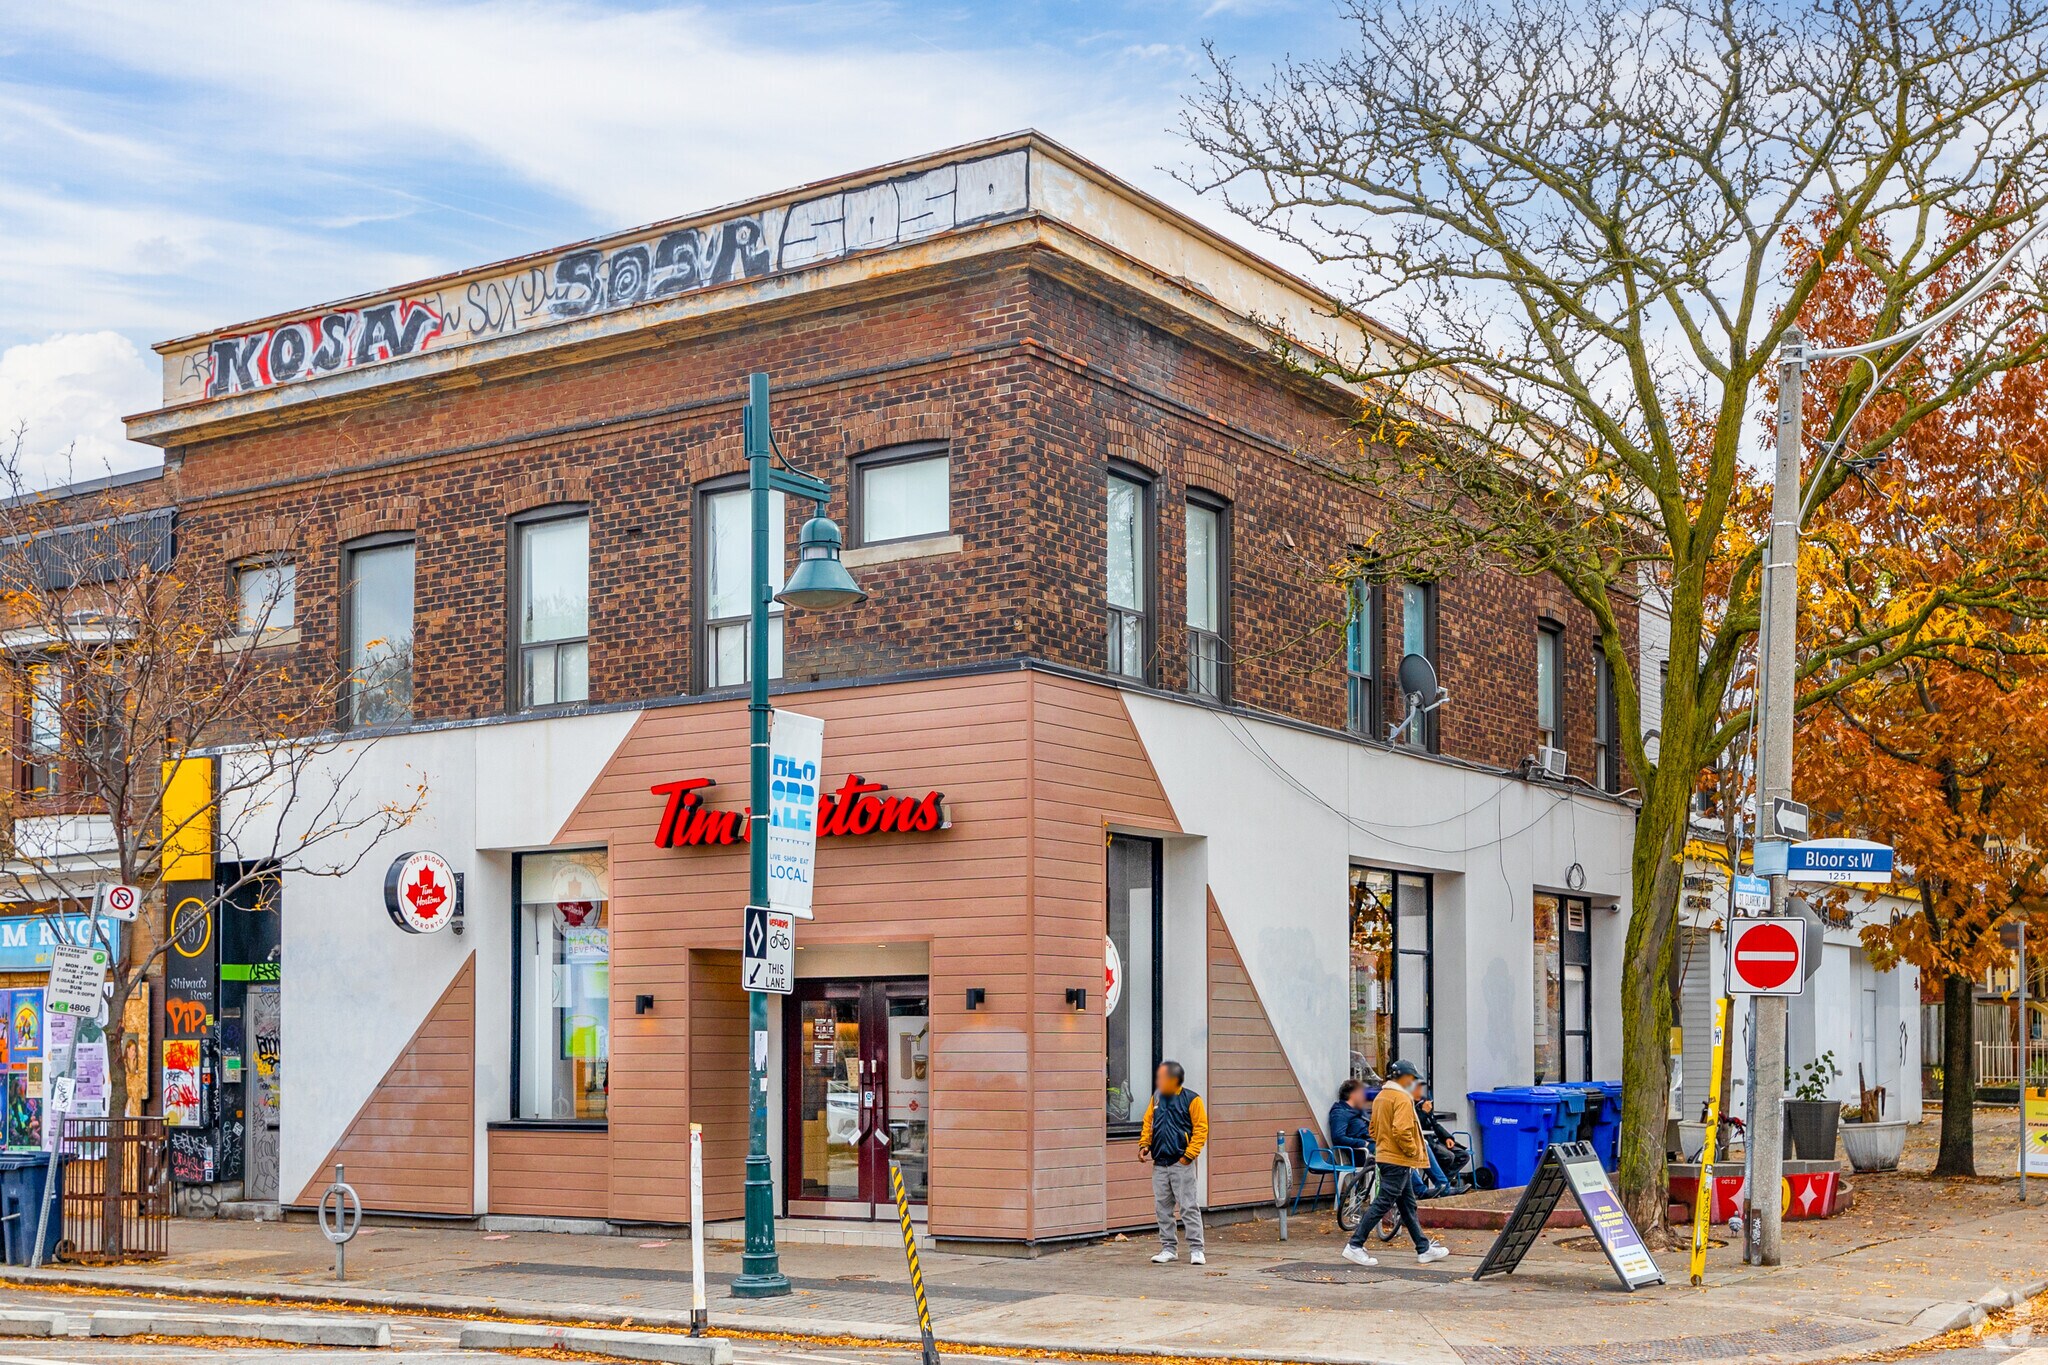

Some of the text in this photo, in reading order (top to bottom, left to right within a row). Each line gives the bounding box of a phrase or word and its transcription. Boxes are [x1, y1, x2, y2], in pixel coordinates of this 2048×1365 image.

[651, 777, 744, 848] Tim
[770, 806, 811, 832] ALE
[409, 854, 444, 868] 1251 BLOOR
[769, 853, 781, 861] LIVE
[784, 855, 797, 863] SHOP
[1805, 851, 1874, 868] Bloor St W
[770, 863, 808, 883] LOCAL
[1828, 872, 1852, 881] 1251
[420, 884, 433, 895] Tim
[416, 895, 441, 907] Hortons
[410, 916, 444, 930] TORONTO
[2, 923, 28, 947] M
[768, 963, 784, 975] THIS
[765, 977, 785, 989] LANE
[190, 990, 212, 1000] Rose
[69, 1003, 91, 1013] 4806
